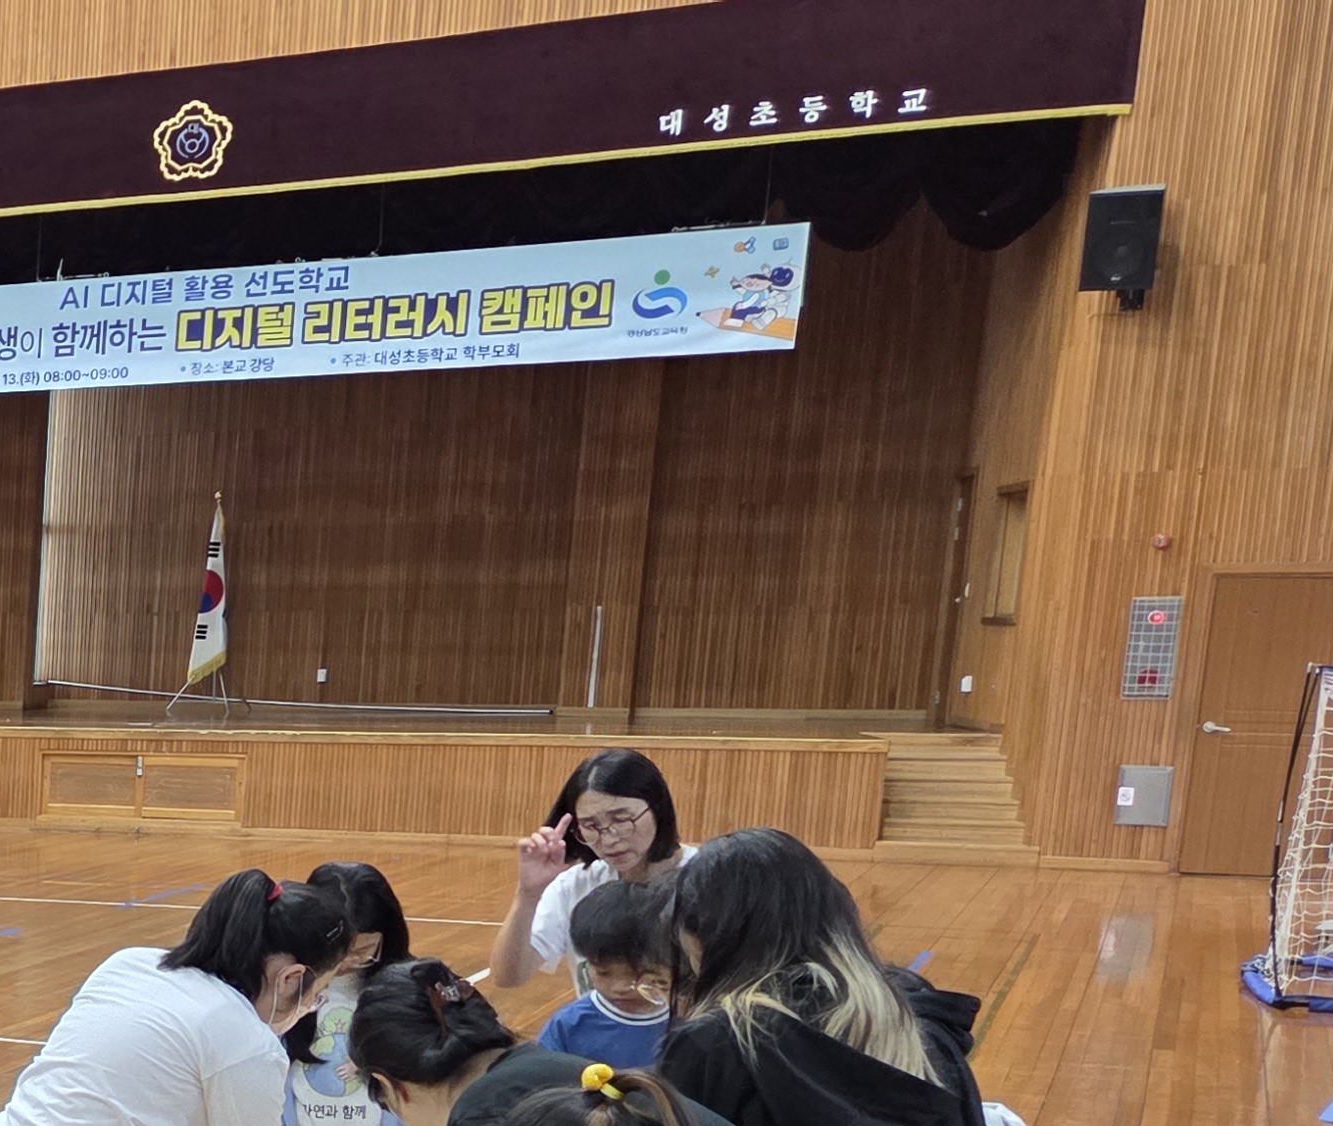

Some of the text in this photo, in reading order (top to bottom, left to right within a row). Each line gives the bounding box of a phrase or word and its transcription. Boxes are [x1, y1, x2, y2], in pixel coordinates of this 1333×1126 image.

[659, 90, 927, 136] 대성초등학교
[59, 266, 349, 310] AI 디지털 활용 선도학교
[51, 319, 167, 356] 함께하는
[176, 303, 295, 350] 디지털
[303, 290, 467, 344] 리터러시
[479, 280, 615, 333] 캠페인
[190, 356, 275, 375] 장소: 본교 강당
[342, 343, 520, 367] 주관: 대성초등학교 학부모회
[44, 367, 129, 383] 08:00~09:00
[342, 1104, 366, 1119] 함께
